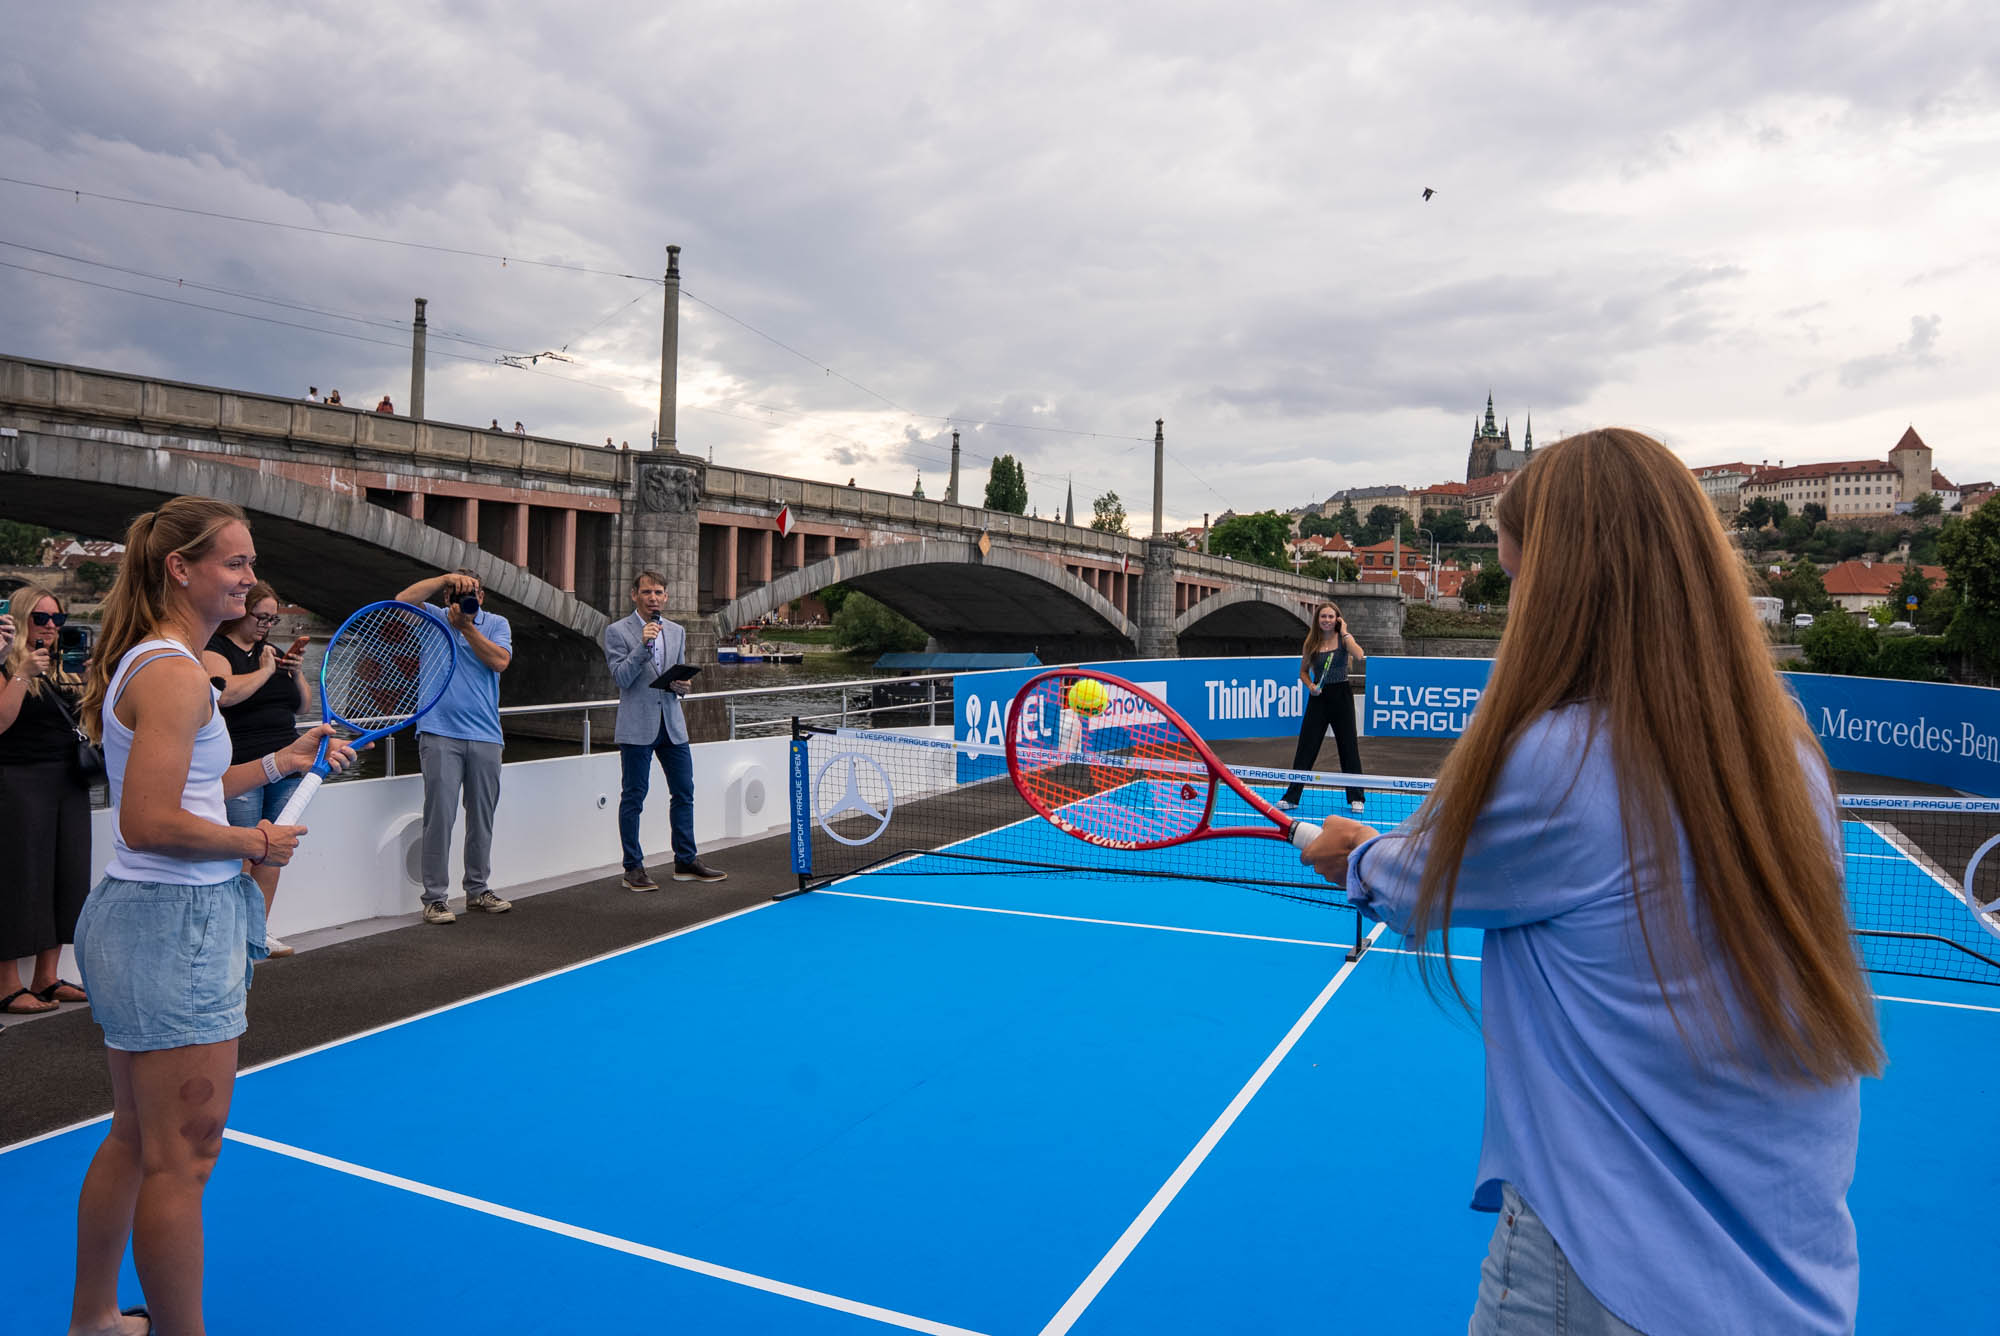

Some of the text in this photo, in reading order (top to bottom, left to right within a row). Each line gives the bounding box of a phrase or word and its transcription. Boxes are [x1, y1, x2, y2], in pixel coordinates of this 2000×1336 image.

[1205, 679, 1303, 720] ThinkPad
[1374, 685, 1481, 708] LIVESP
[1373, 709, 1468, 732] PRAGU
[855, 731, 952, 749] LIVESPORT PRAGUE OPEN
[1819, 706, 2000, 763] Mercedes-Ben
[1249, 770, 1287, 780] PRAGUE
[1288, 773, 1313, 782] OPEN
[796, 779, 804, 816] PRAGUE
[1842, 798, 2000, 811] LIVESPORT PRAGUE OPEN
[796, 818, 806, 869] LIVESPORT
